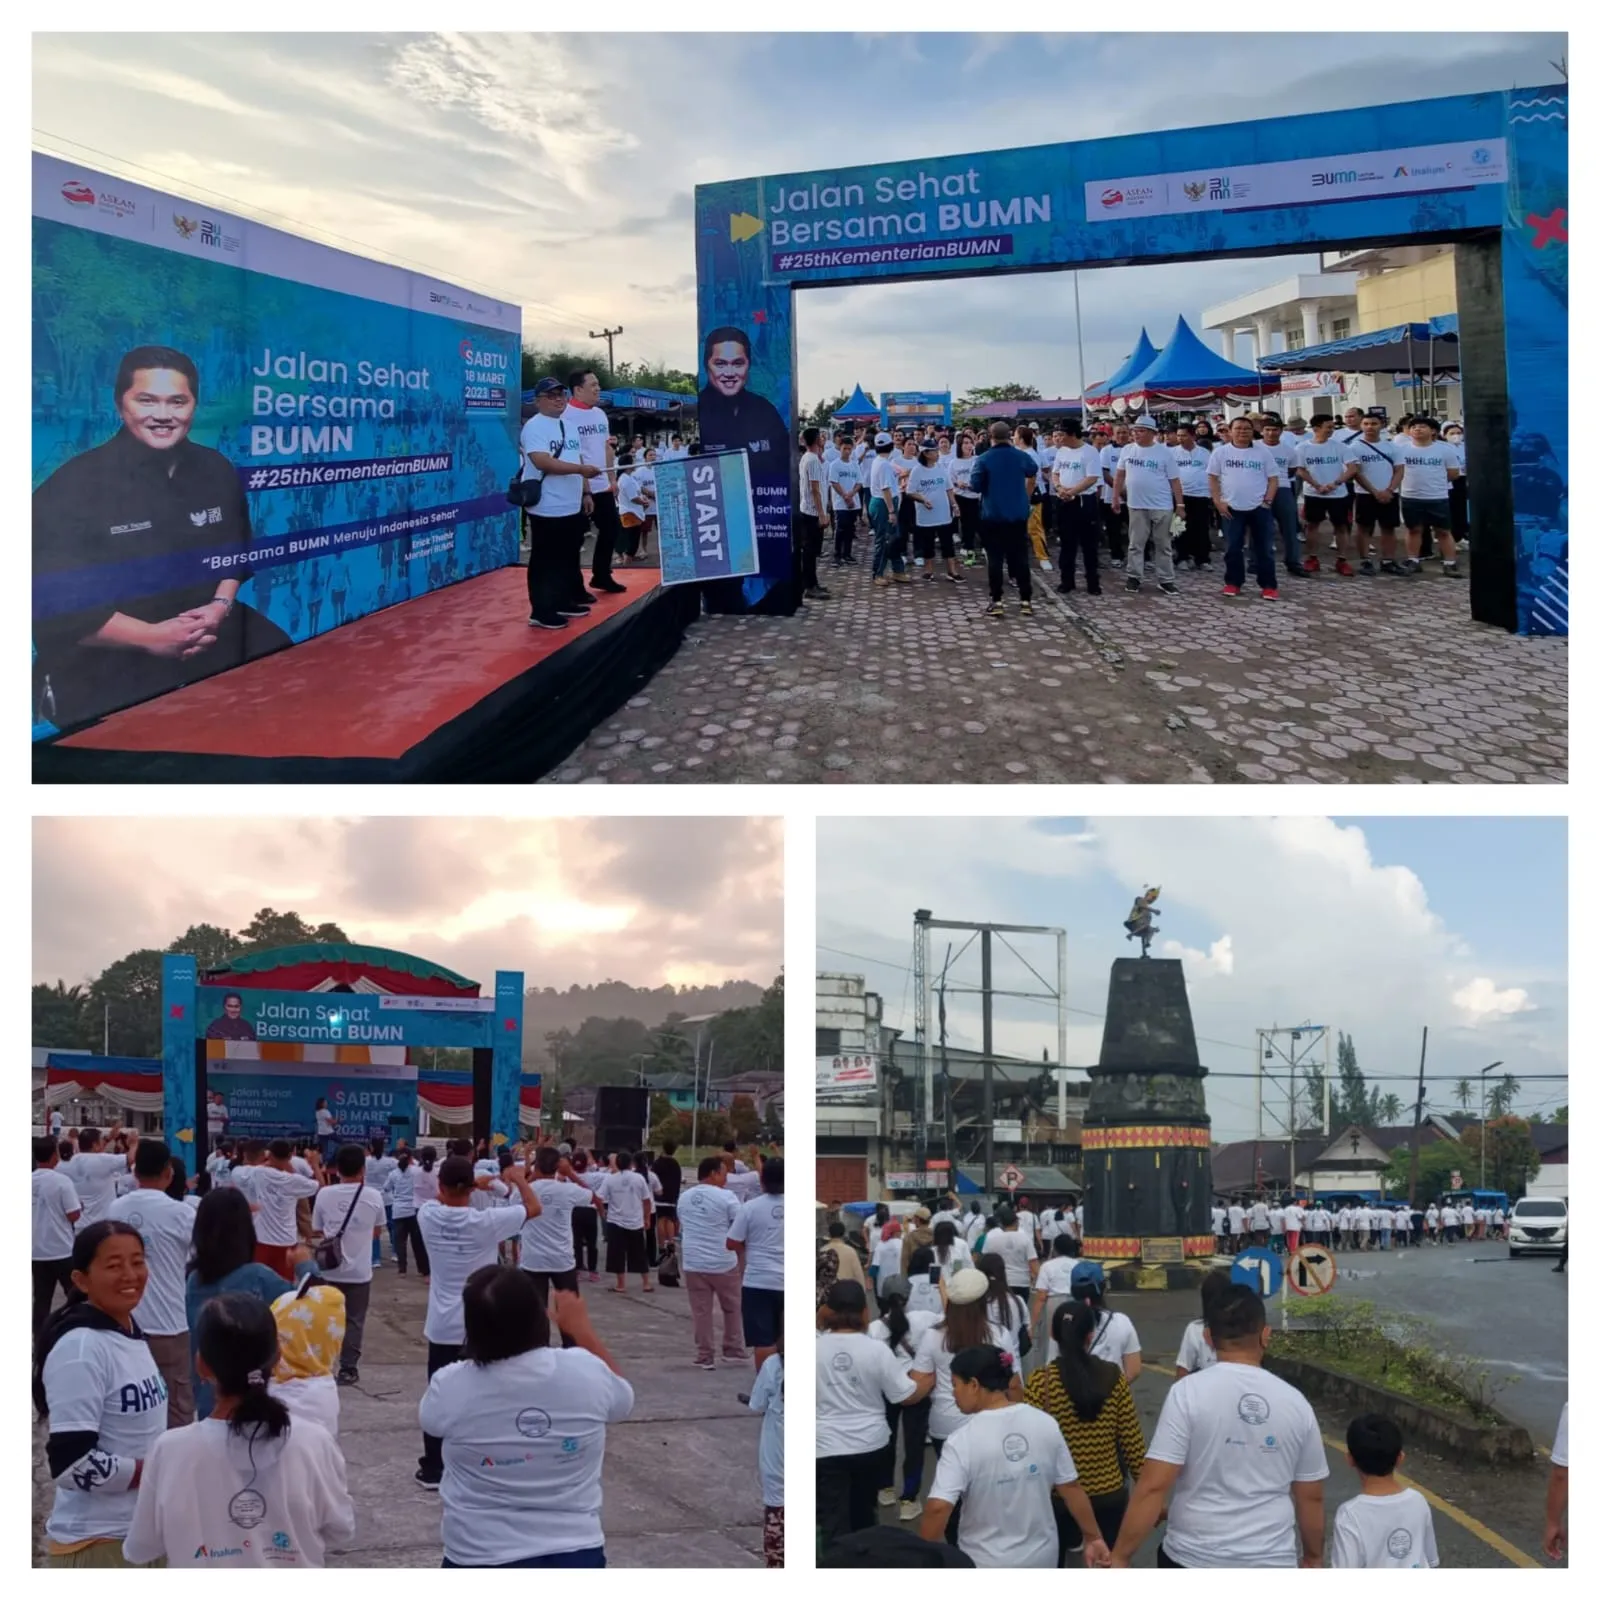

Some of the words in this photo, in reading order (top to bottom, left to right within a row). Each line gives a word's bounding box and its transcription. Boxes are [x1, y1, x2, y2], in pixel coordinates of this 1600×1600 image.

[771, 181, 864, 214] Jalan
[876, 168, 980, 203] Sehat
[772, 210, 926, 246] Bersama
[939, 194, 1051, 231] BUMN
[779, 239, 1001, 270] #25thKementerianBUMN
[253, 349, 347, 384] Jalan
[358, 361, 429, 389] Sehat
[465, 350, 508, 369] SABTU
[465, 369, 476, 382] 18
[477, 371, 506, 385] MARET
[253, 385, 394, 419] Bersama
[465, 386, 488, 399] 2023
[251, 425, 353, 456] BUMN
[249, 457, 448, 488] #25thKementerianBUMN
[756, 487, 788, 496] BUMN
[692, 465, 723, 560] START
[289, 536, 329, 554] BUMN
[333, 527, 376, 545] Menuju
[380, 515, 429, 535] Indonesia
[434, 541, 454, 554] BUMN
[256, 1002, 310, 1020] Jalan
[256, 1022, 342, 1040] Bersama
[348, 1025, 403, 1041] BUMN
[230, 1087, 260, 1098] Jalan
[262, 1088, 292, 1098] Sehat
[335, 1091, 393, 1106] SABTU
[230, 1109, 262, 1118] BUMN
[335, 1125, 364, 1136] 2023
